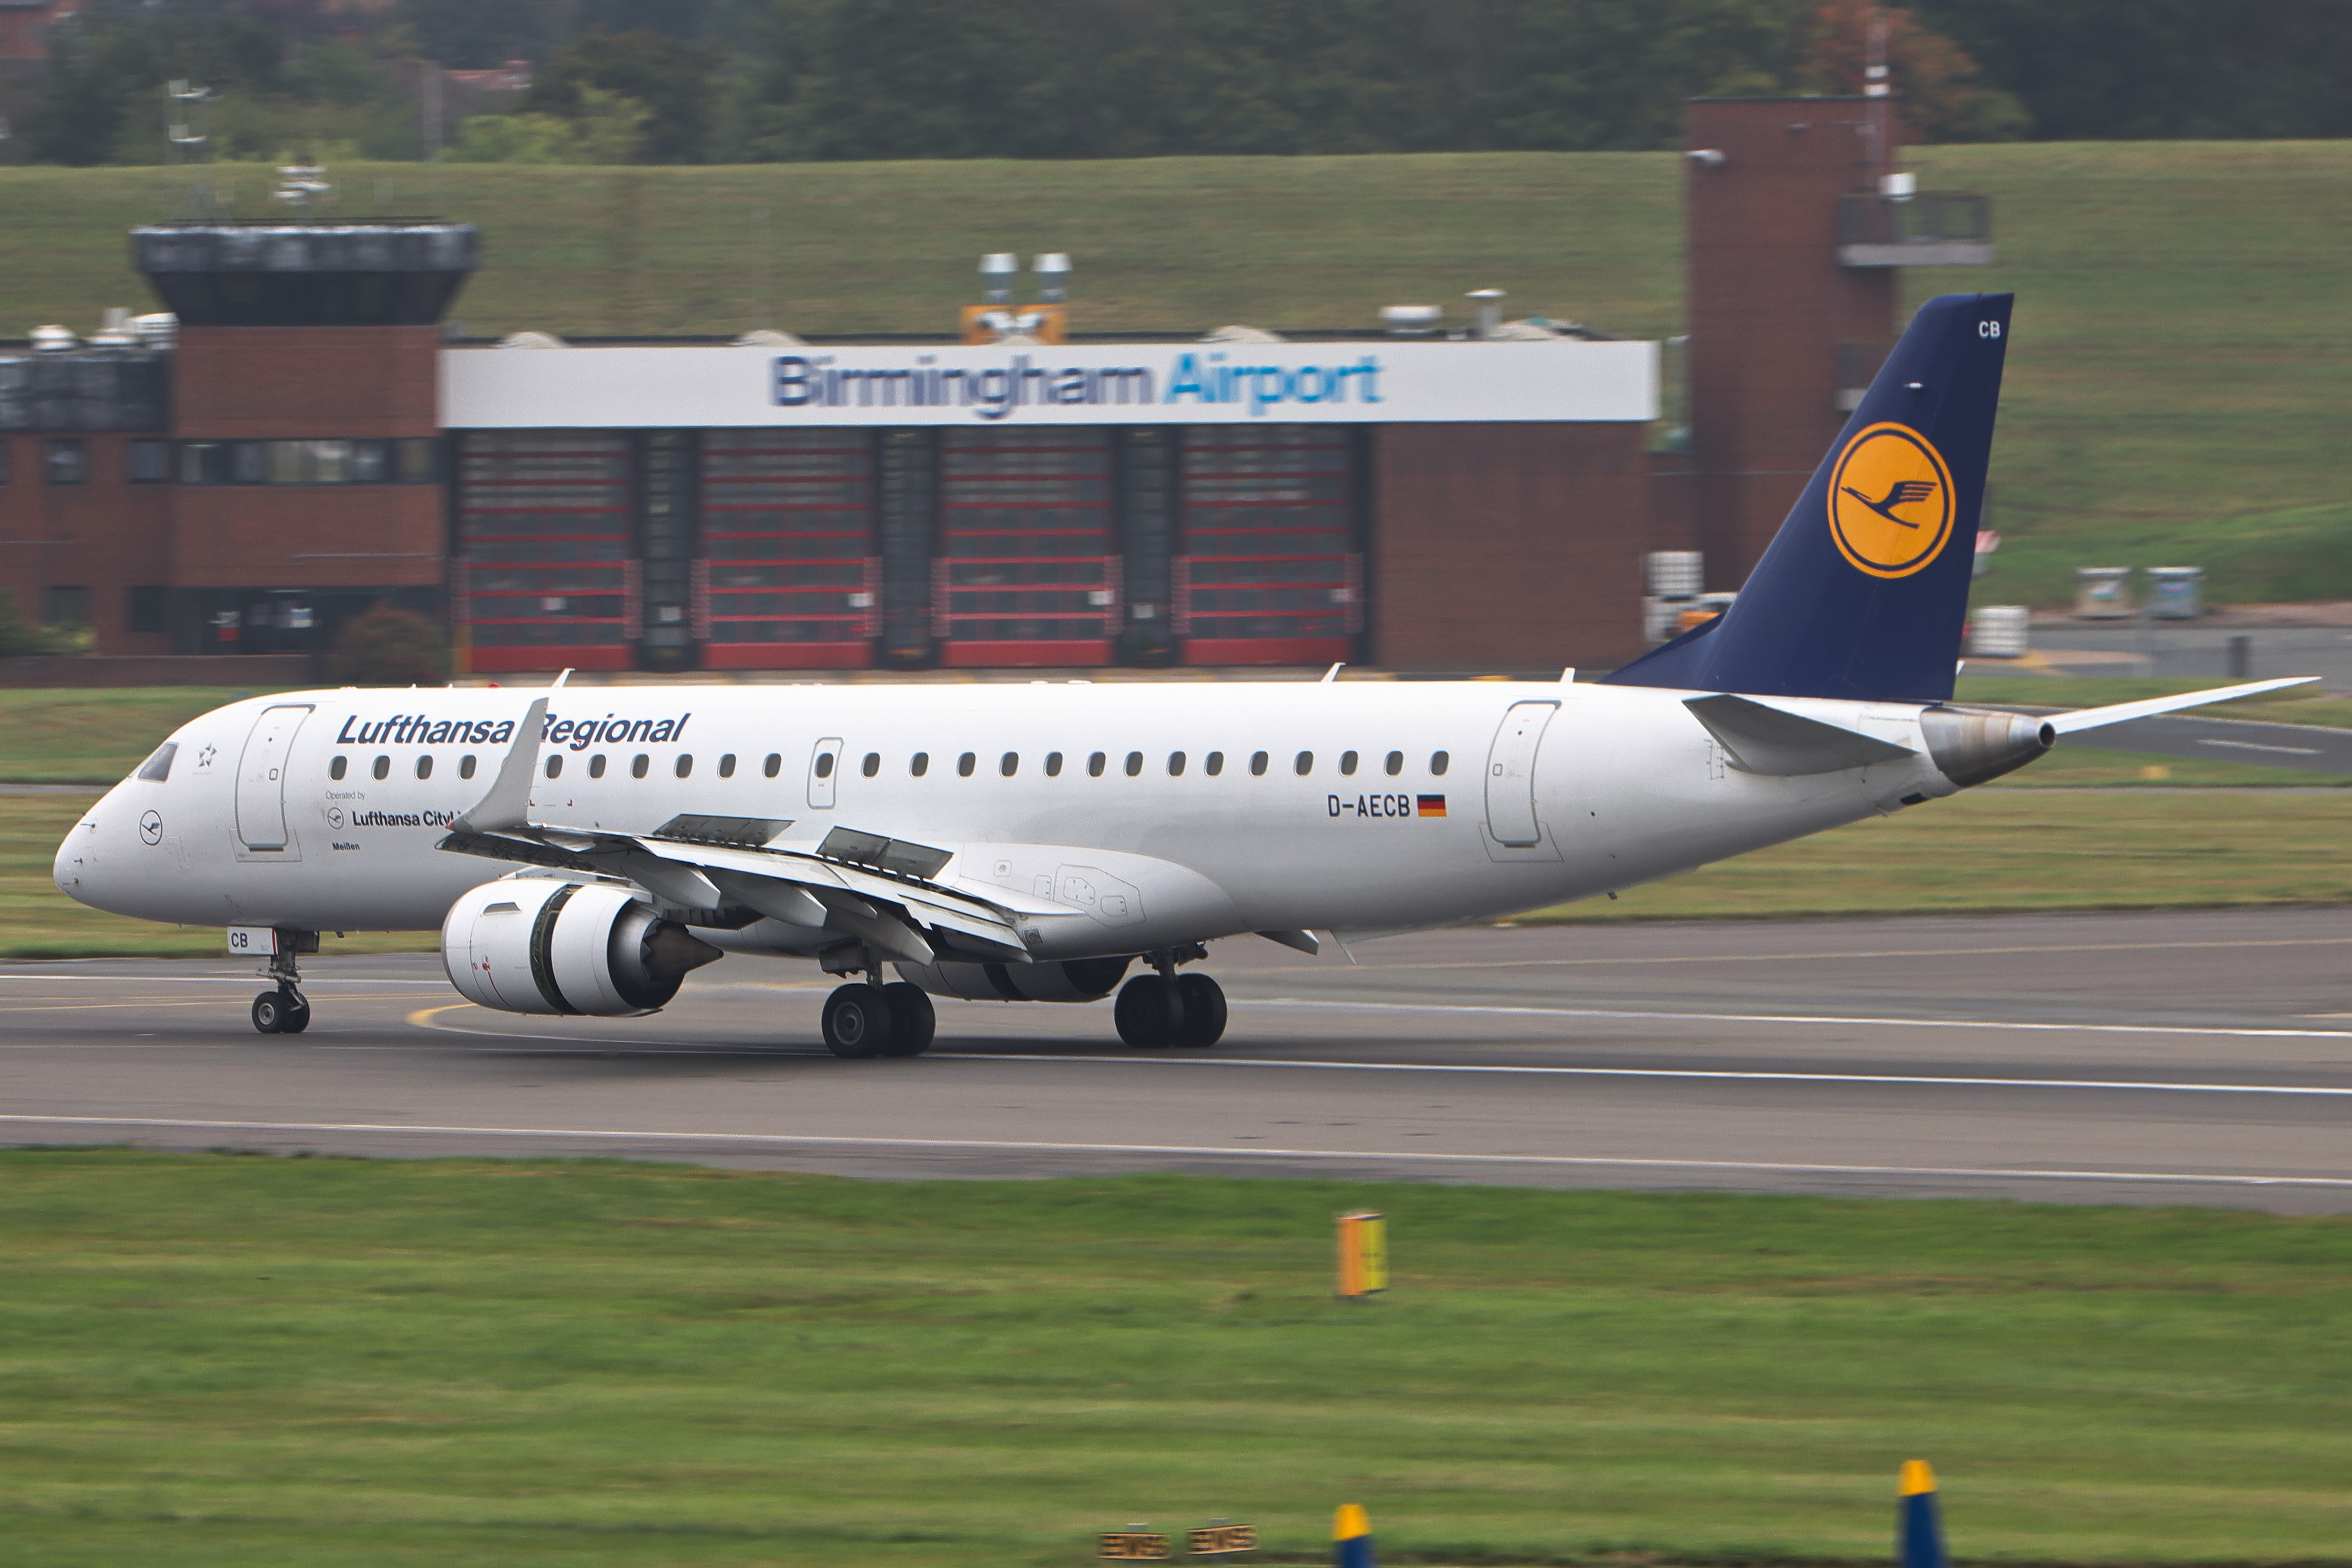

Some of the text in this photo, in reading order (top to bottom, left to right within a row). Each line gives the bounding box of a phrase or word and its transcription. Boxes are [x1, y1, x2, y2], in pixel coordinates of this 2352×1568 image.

[1979, 321, 2001, 338] CB
[770, 352, 1385, 420] Birmingham Airport
[336, 713, 692, 751] Lufthansa Regional
[326, 790, 366, 801] Operated by
[1328, 793, 1410, 817] D-AECB
[352, 809, 461, 829] Lufthansa City
[332, 841, 361, 851] Meißen
[231, 932, 248, 947] CB
